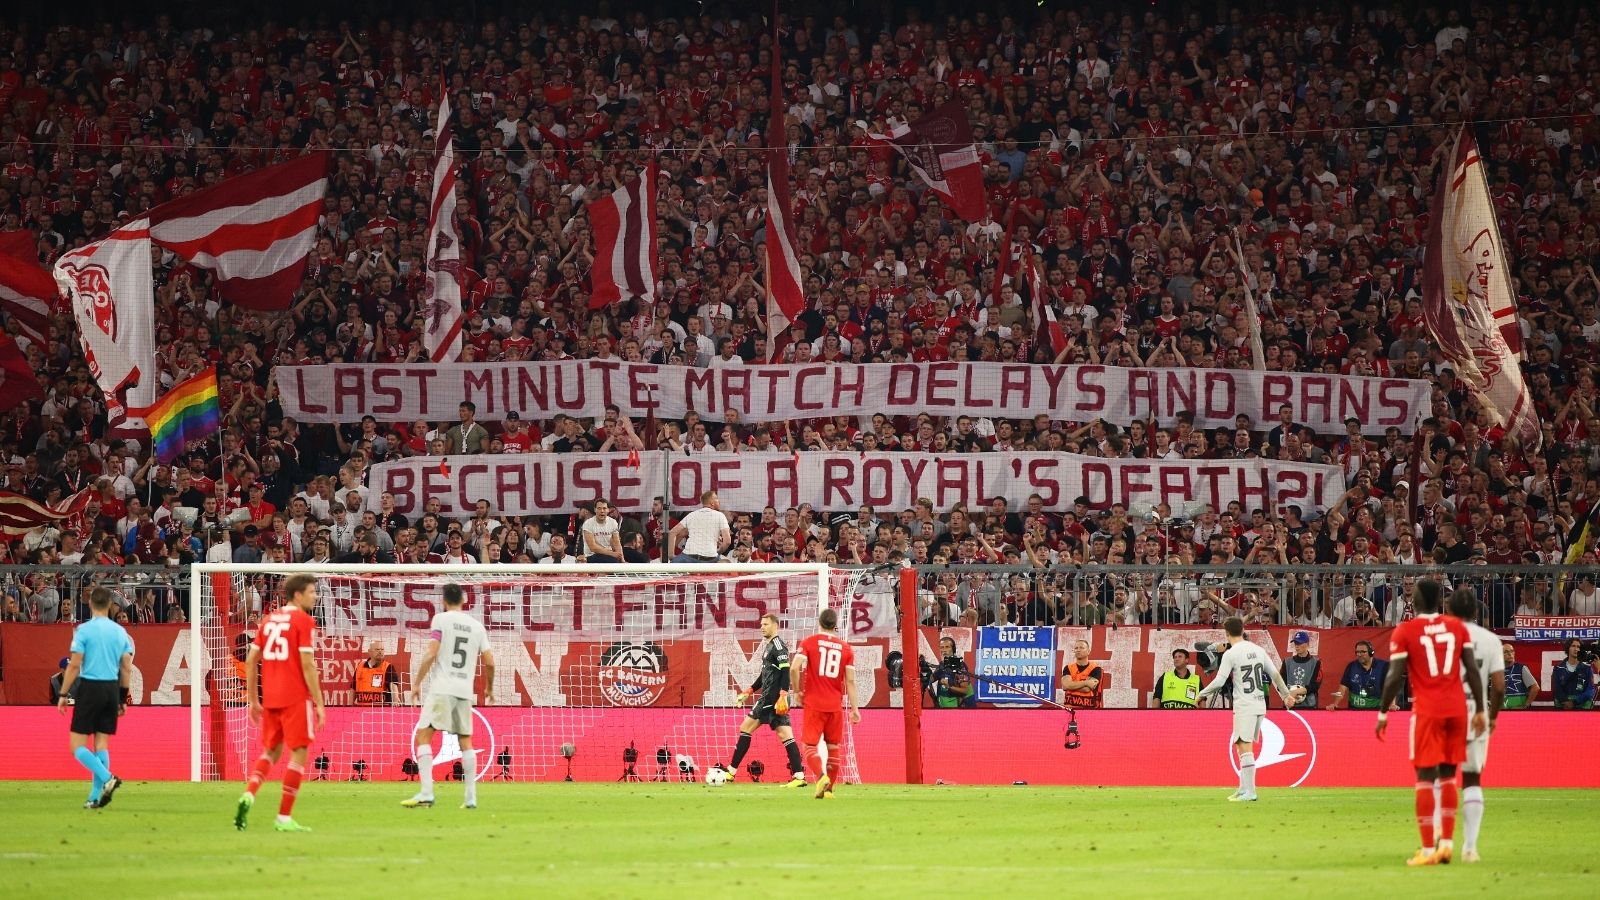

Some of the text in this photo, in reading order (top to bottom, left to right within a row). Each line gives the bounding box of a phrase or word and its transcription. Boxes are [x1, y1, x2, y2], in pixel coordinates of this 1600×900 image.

[297, 361, 1410, 426] LAST MINUTE MATCH DELAYS AND BANS
[386, 459, 642, 513] BECAUSE
[671, 460, 742, 506] OF
[767, 459, 799, 507] A
[823, 458, 1061, 507] ROYAL'S
[613, 578, 788, 632] FANS!
[998, 630, 1036, 643] GUTE
[1515, 618, 1546, 627] GUTE
[1515, 629, 1541, 638] SIND
[1543, 630, 1563, 638] NIE
[262, 621, 291, 661] 25
[451, 636, 469, 669] 5
[982, 648, 1050, 660] FREUNDE
[1419, 631, 1456, 678] 17
[617, 669, 666, 686] BAYERN
[818, 646, 842, 679] 18
[983, 665, 1047, 677] SIND NIE
[1240, 662, 1264, 694] 30
[606, 686, 653, 706] MÜNCHEN
